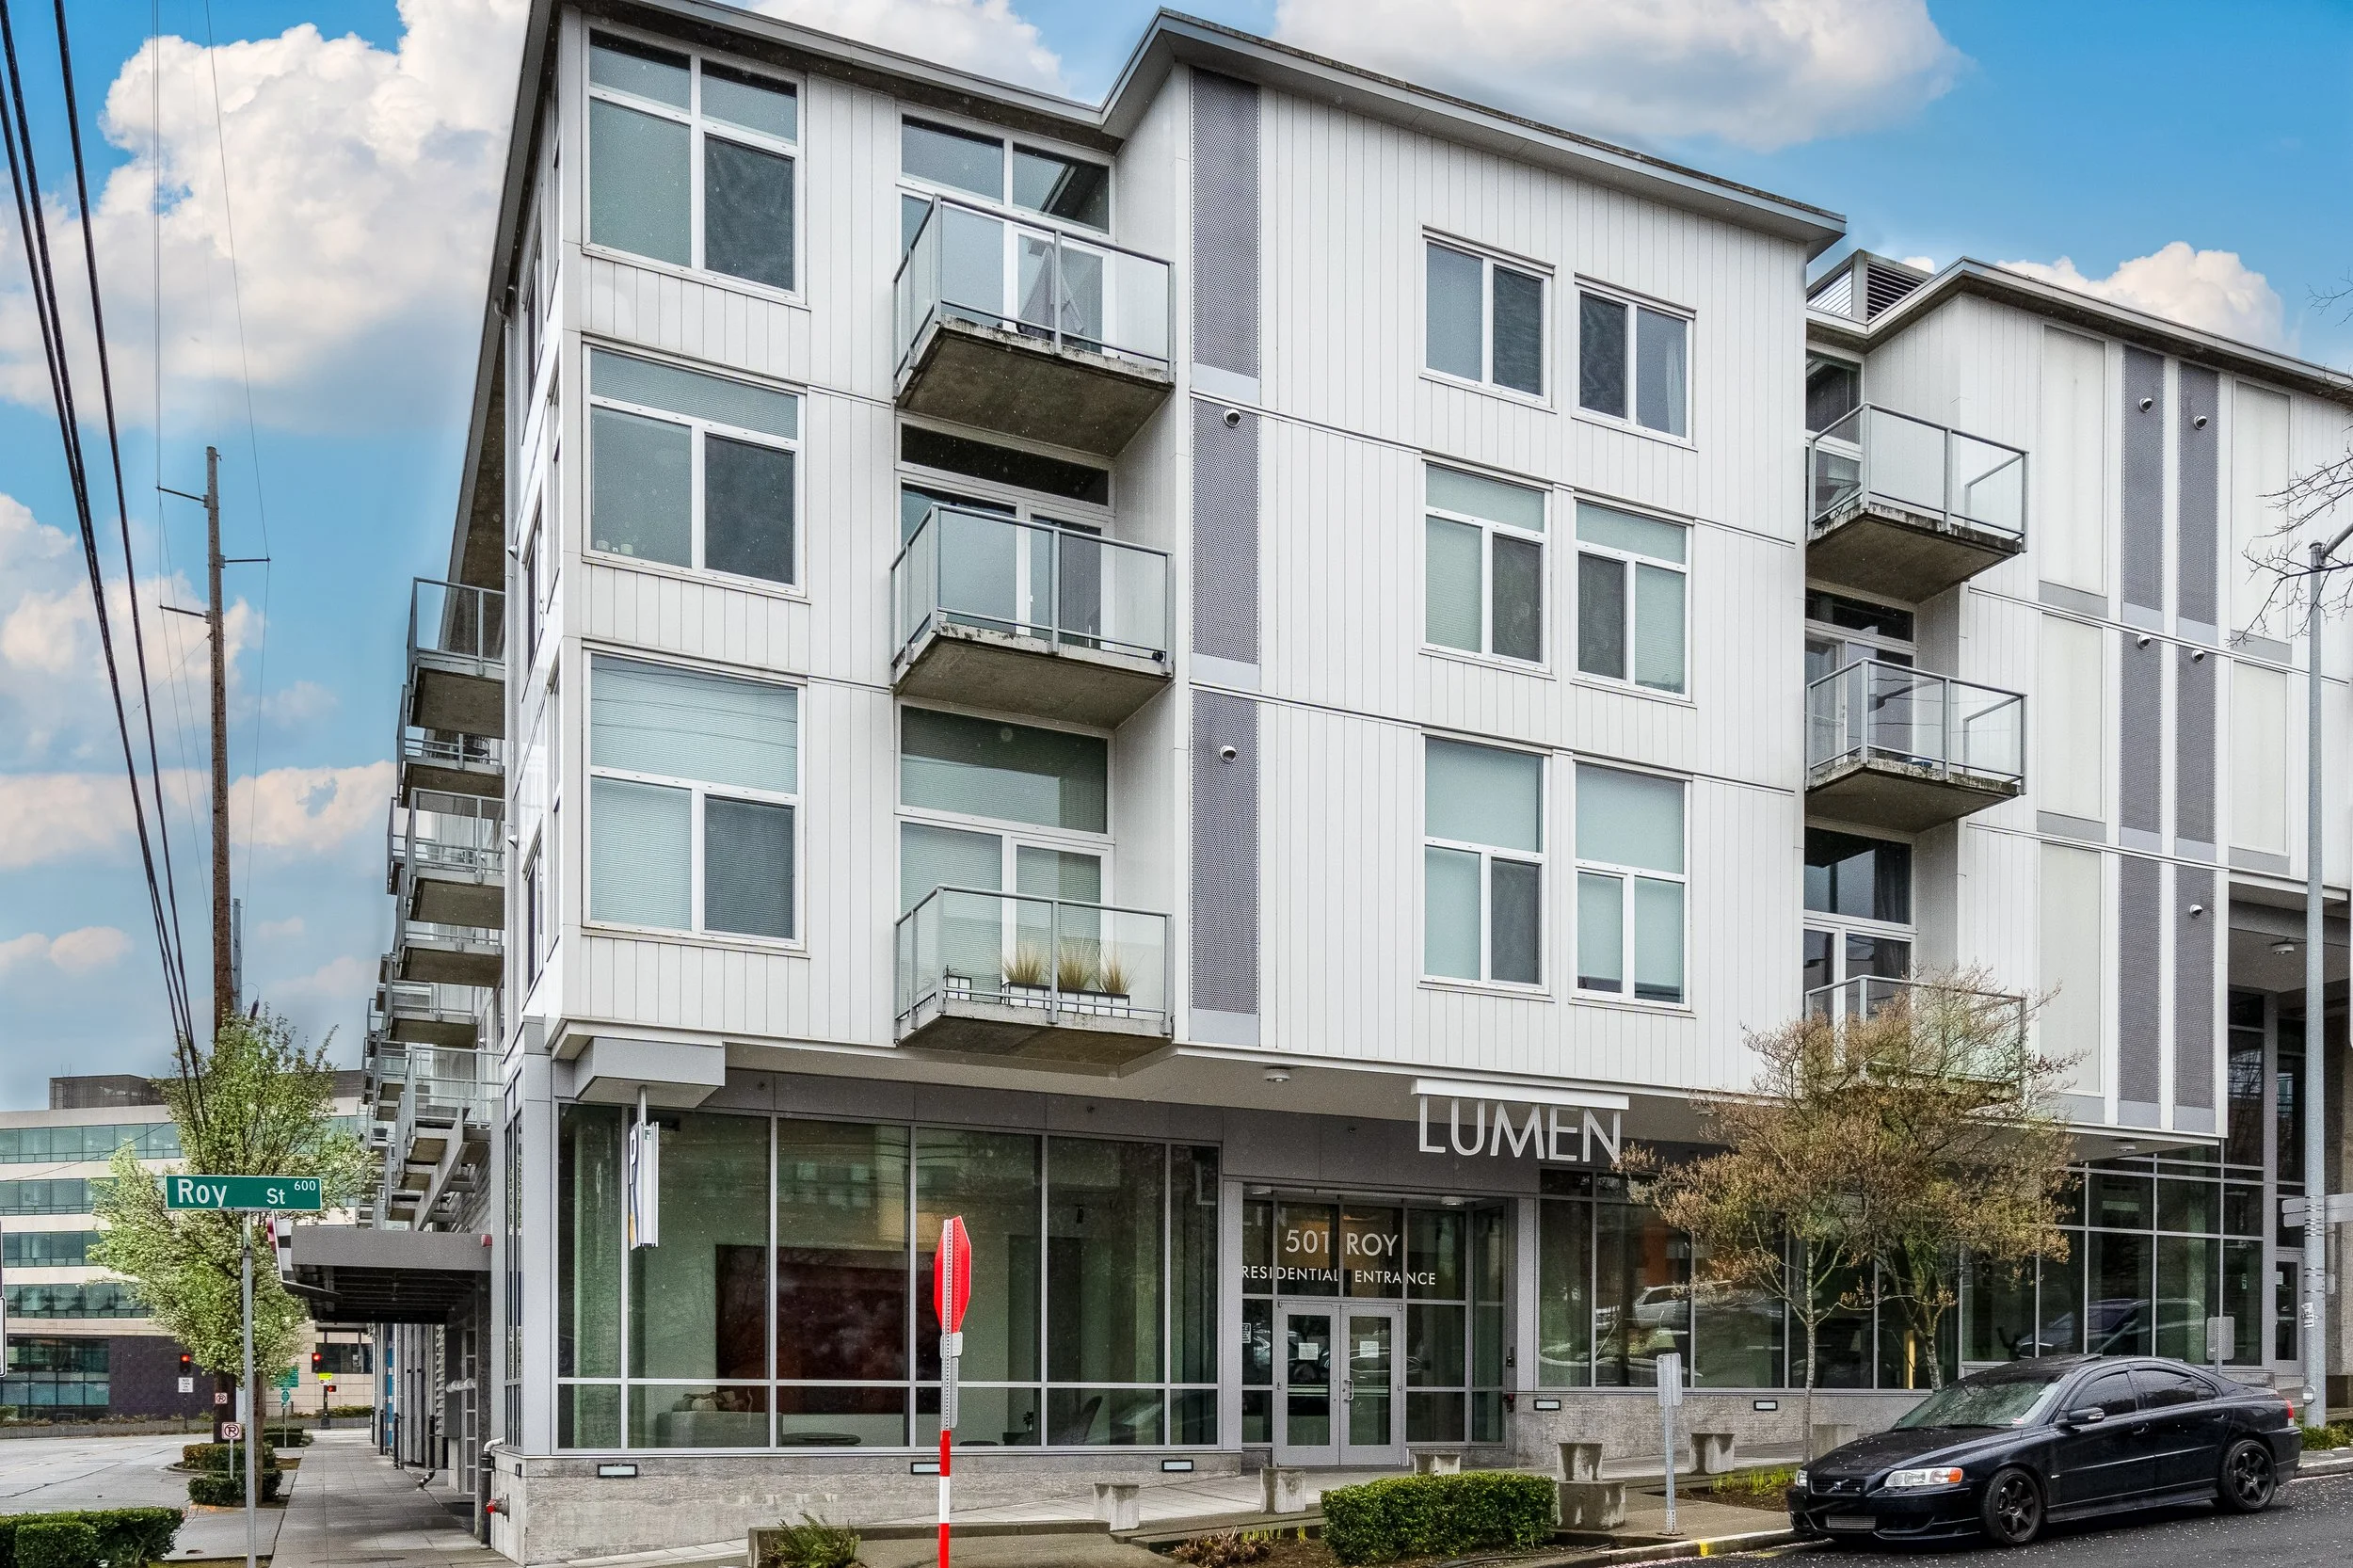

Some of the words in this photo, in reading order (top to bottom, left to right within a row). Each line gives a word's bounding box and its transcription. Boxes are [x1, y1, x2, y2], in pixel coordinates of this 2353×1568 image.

[1419, 1094, 1621, 1163] LUMEN
[177, 1178, 228, 1208] Roy
[266, 1188, 286, 1205] St
[294, 1180, 316, 1192] 600
[1286, 1229, 1330, 1254] 501
[1346, 1232, 1399, 1256] ROY
[1241, 1265, 1339, 1282] RESIDENTIAL
[1354, 1270, 1436, 1286] ENTRANCE
